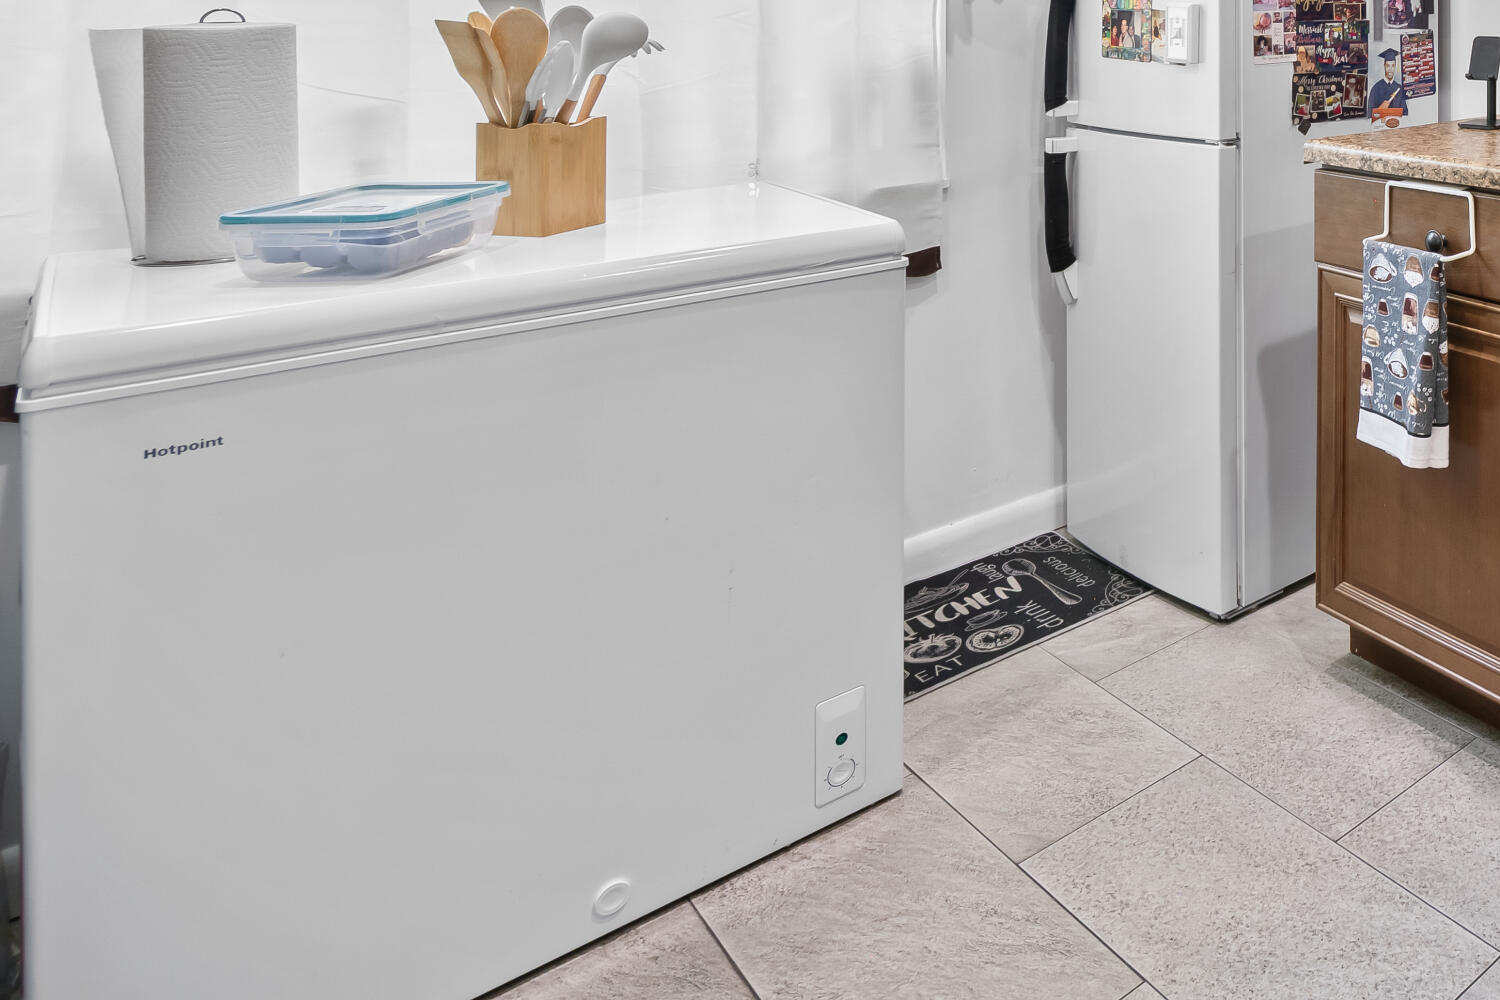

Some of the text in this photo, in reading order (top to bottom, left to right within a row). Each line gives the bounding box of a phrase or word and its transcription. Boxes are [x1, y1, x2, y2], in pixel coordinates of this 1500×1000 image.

[143, 435, 225, 460] Hotpoint
[972, 561, 1005, 584] laugh
[1042, 556, 1097, 588] delicious
[1012, 600, 1064, 630] drink
[914, 655, 963, 683] EAT
